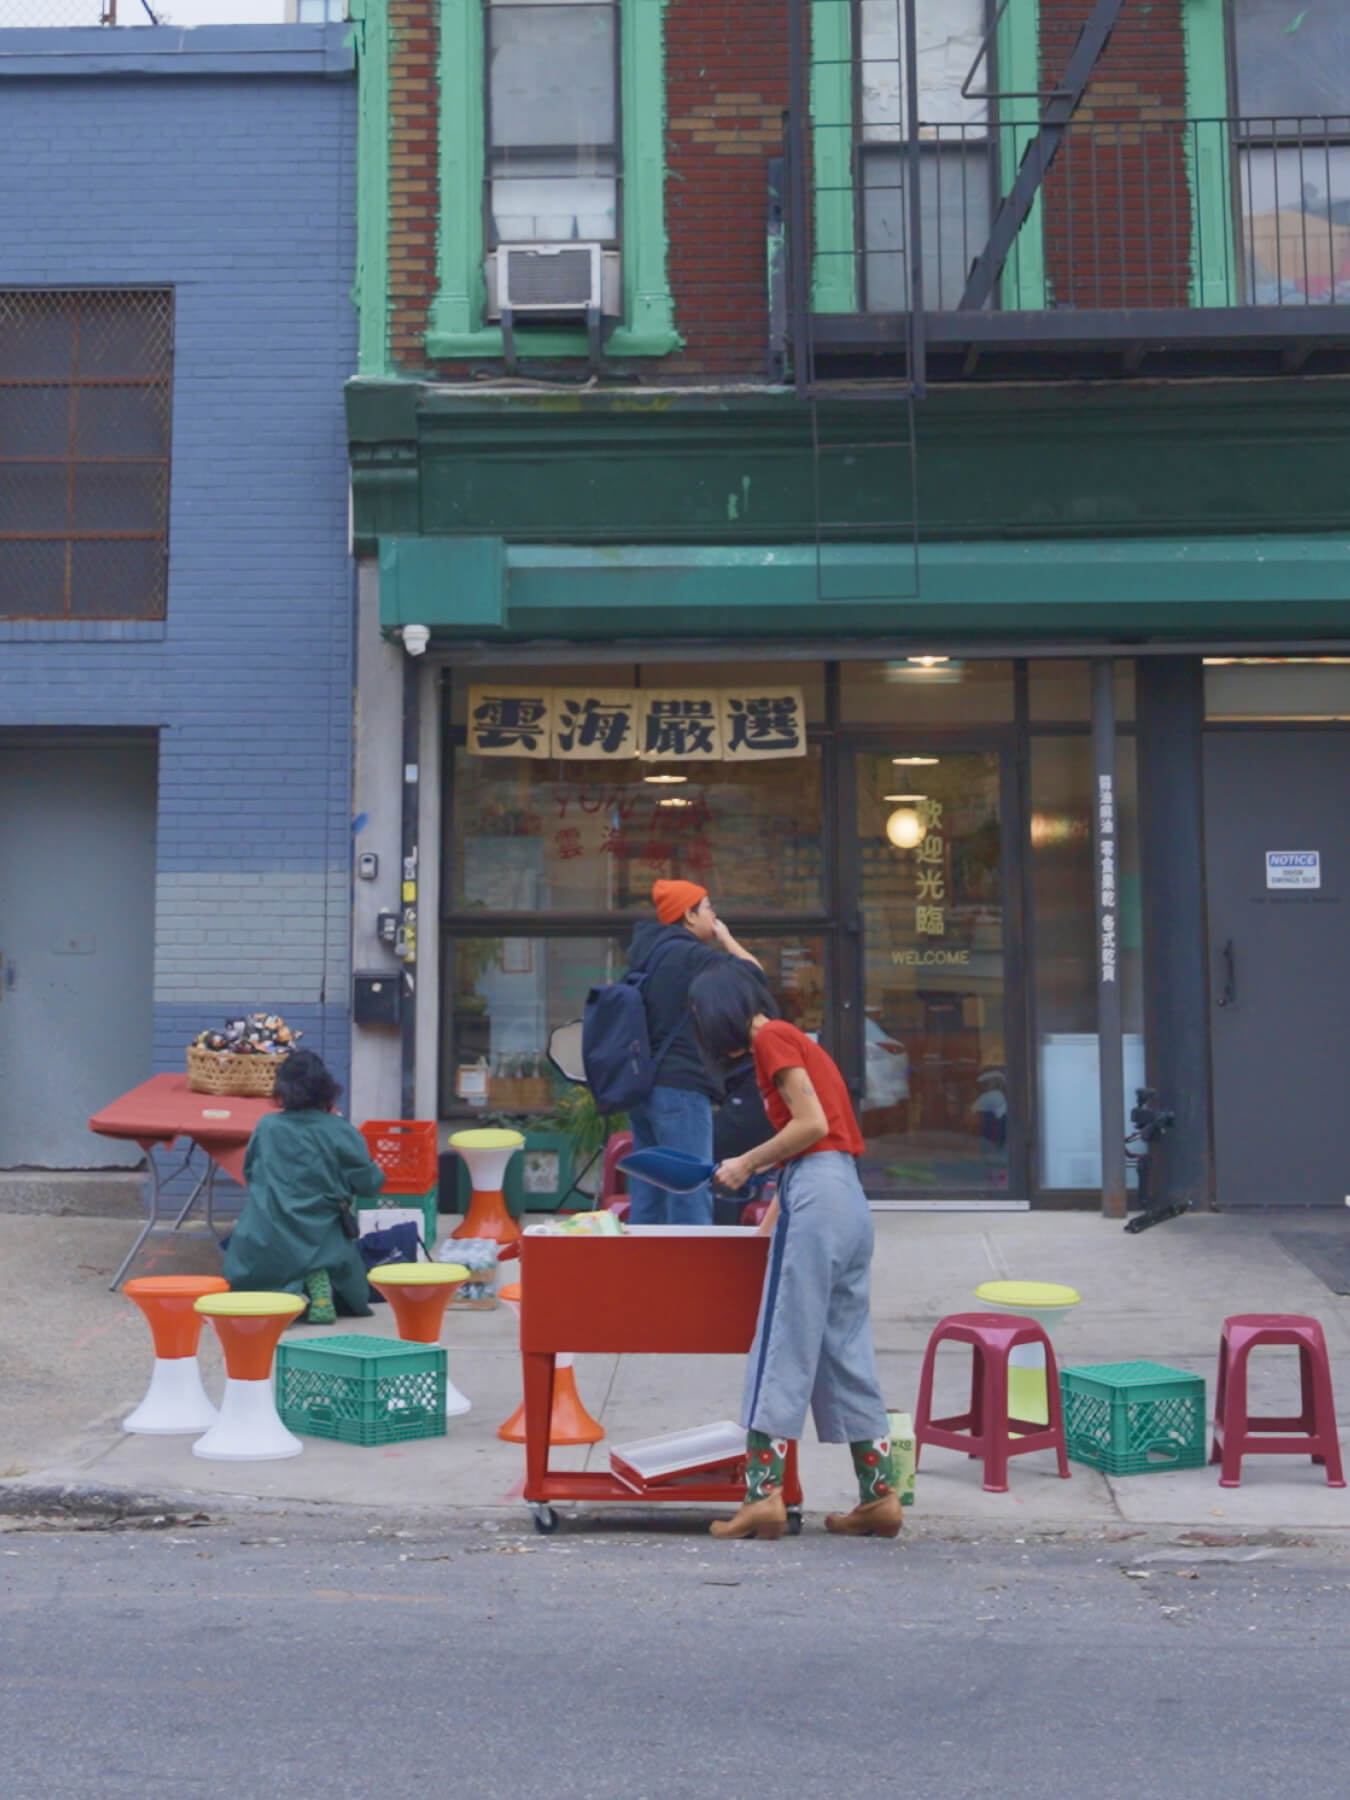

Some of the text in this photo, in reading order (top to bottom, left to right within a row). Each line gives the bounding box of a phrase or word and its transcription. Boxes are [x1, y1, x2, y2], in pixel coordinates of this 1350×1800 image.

[473, 697, 799, 753] 雲海嚴選
[1270, 855, 1315, 865] NOTICE
[892, 950, 969, 965] WELCOME
